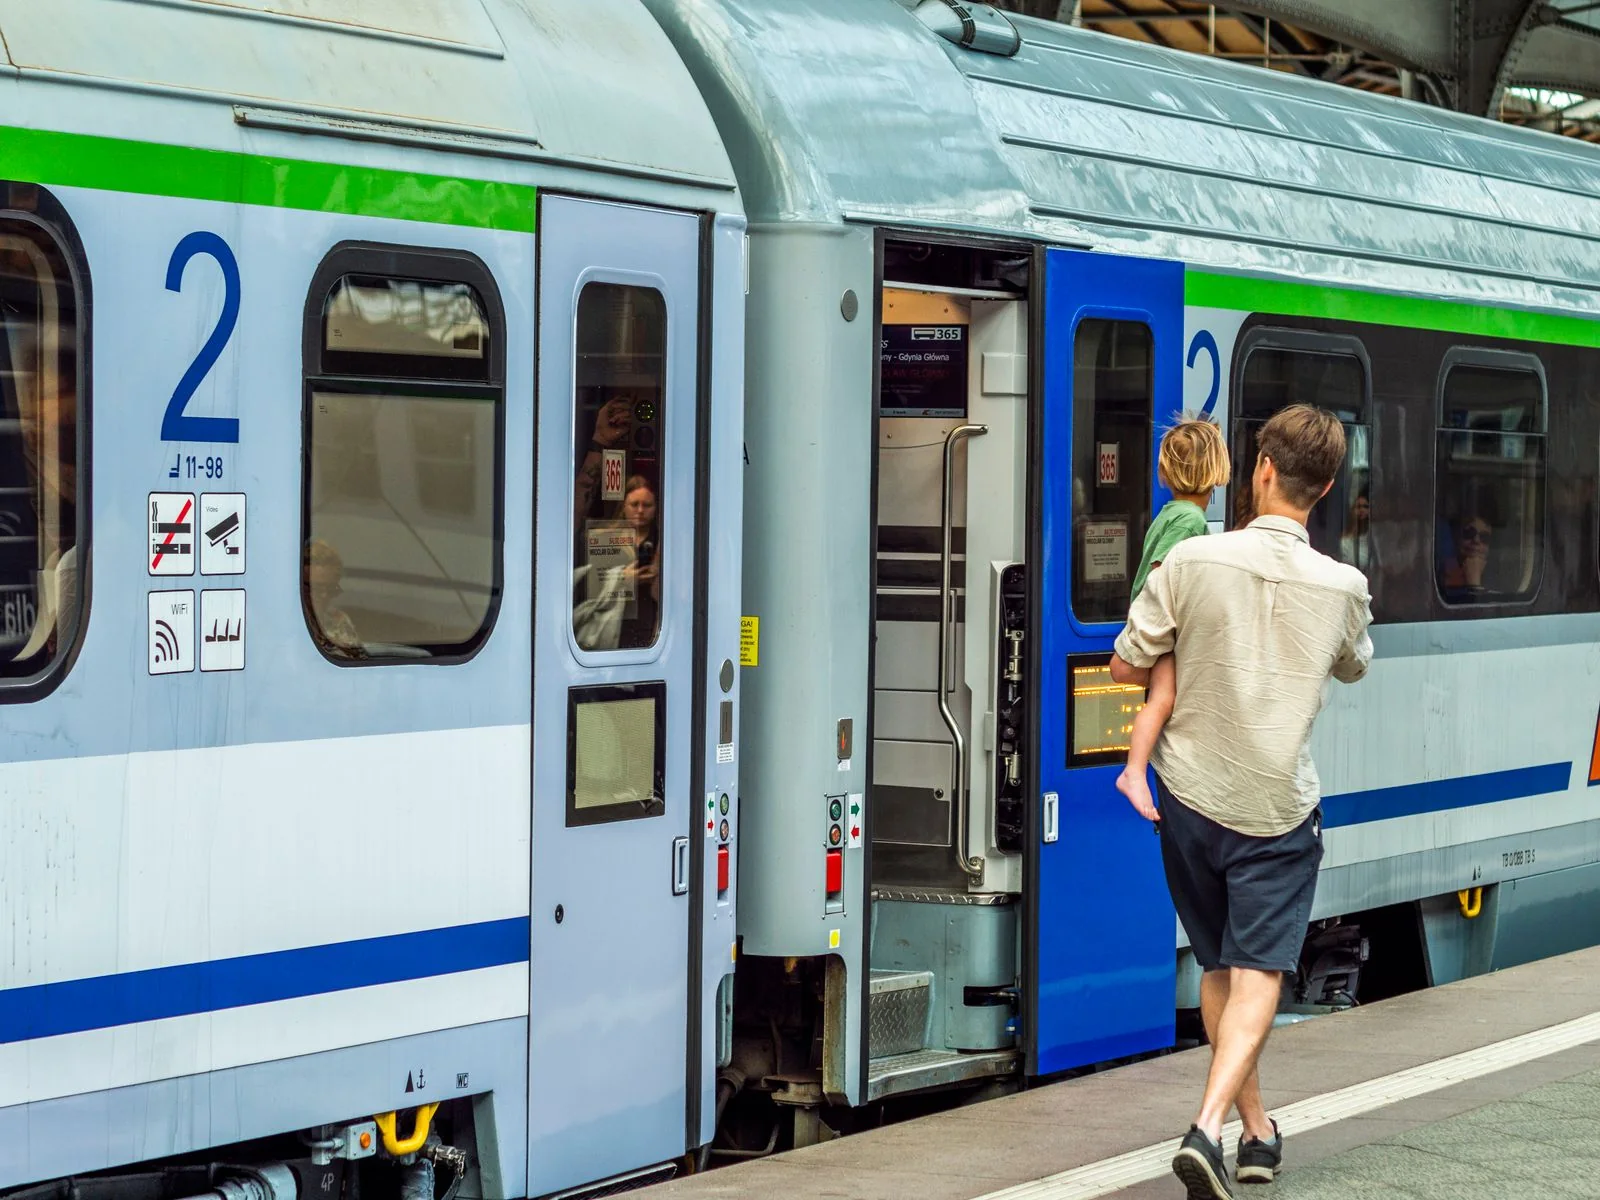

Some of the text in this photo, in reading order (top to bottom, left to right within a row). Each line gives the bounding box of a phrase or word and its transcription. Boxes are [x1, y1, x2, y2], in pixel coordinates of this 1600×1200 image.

[161, 231, 241, 443] 2
[937, 329, 958, 339] 365
[898, 353, 922, 362] Gdynia
[186, 456, 223, 480] 11-98
[605, 459, 621, 491] 366
[1100, 453, 1116, 480] 365
[171, 603, 188, 615] WiFi
[457, 1074, 468, 1087] WC
[321, 1173, 335, 1192] 4P
